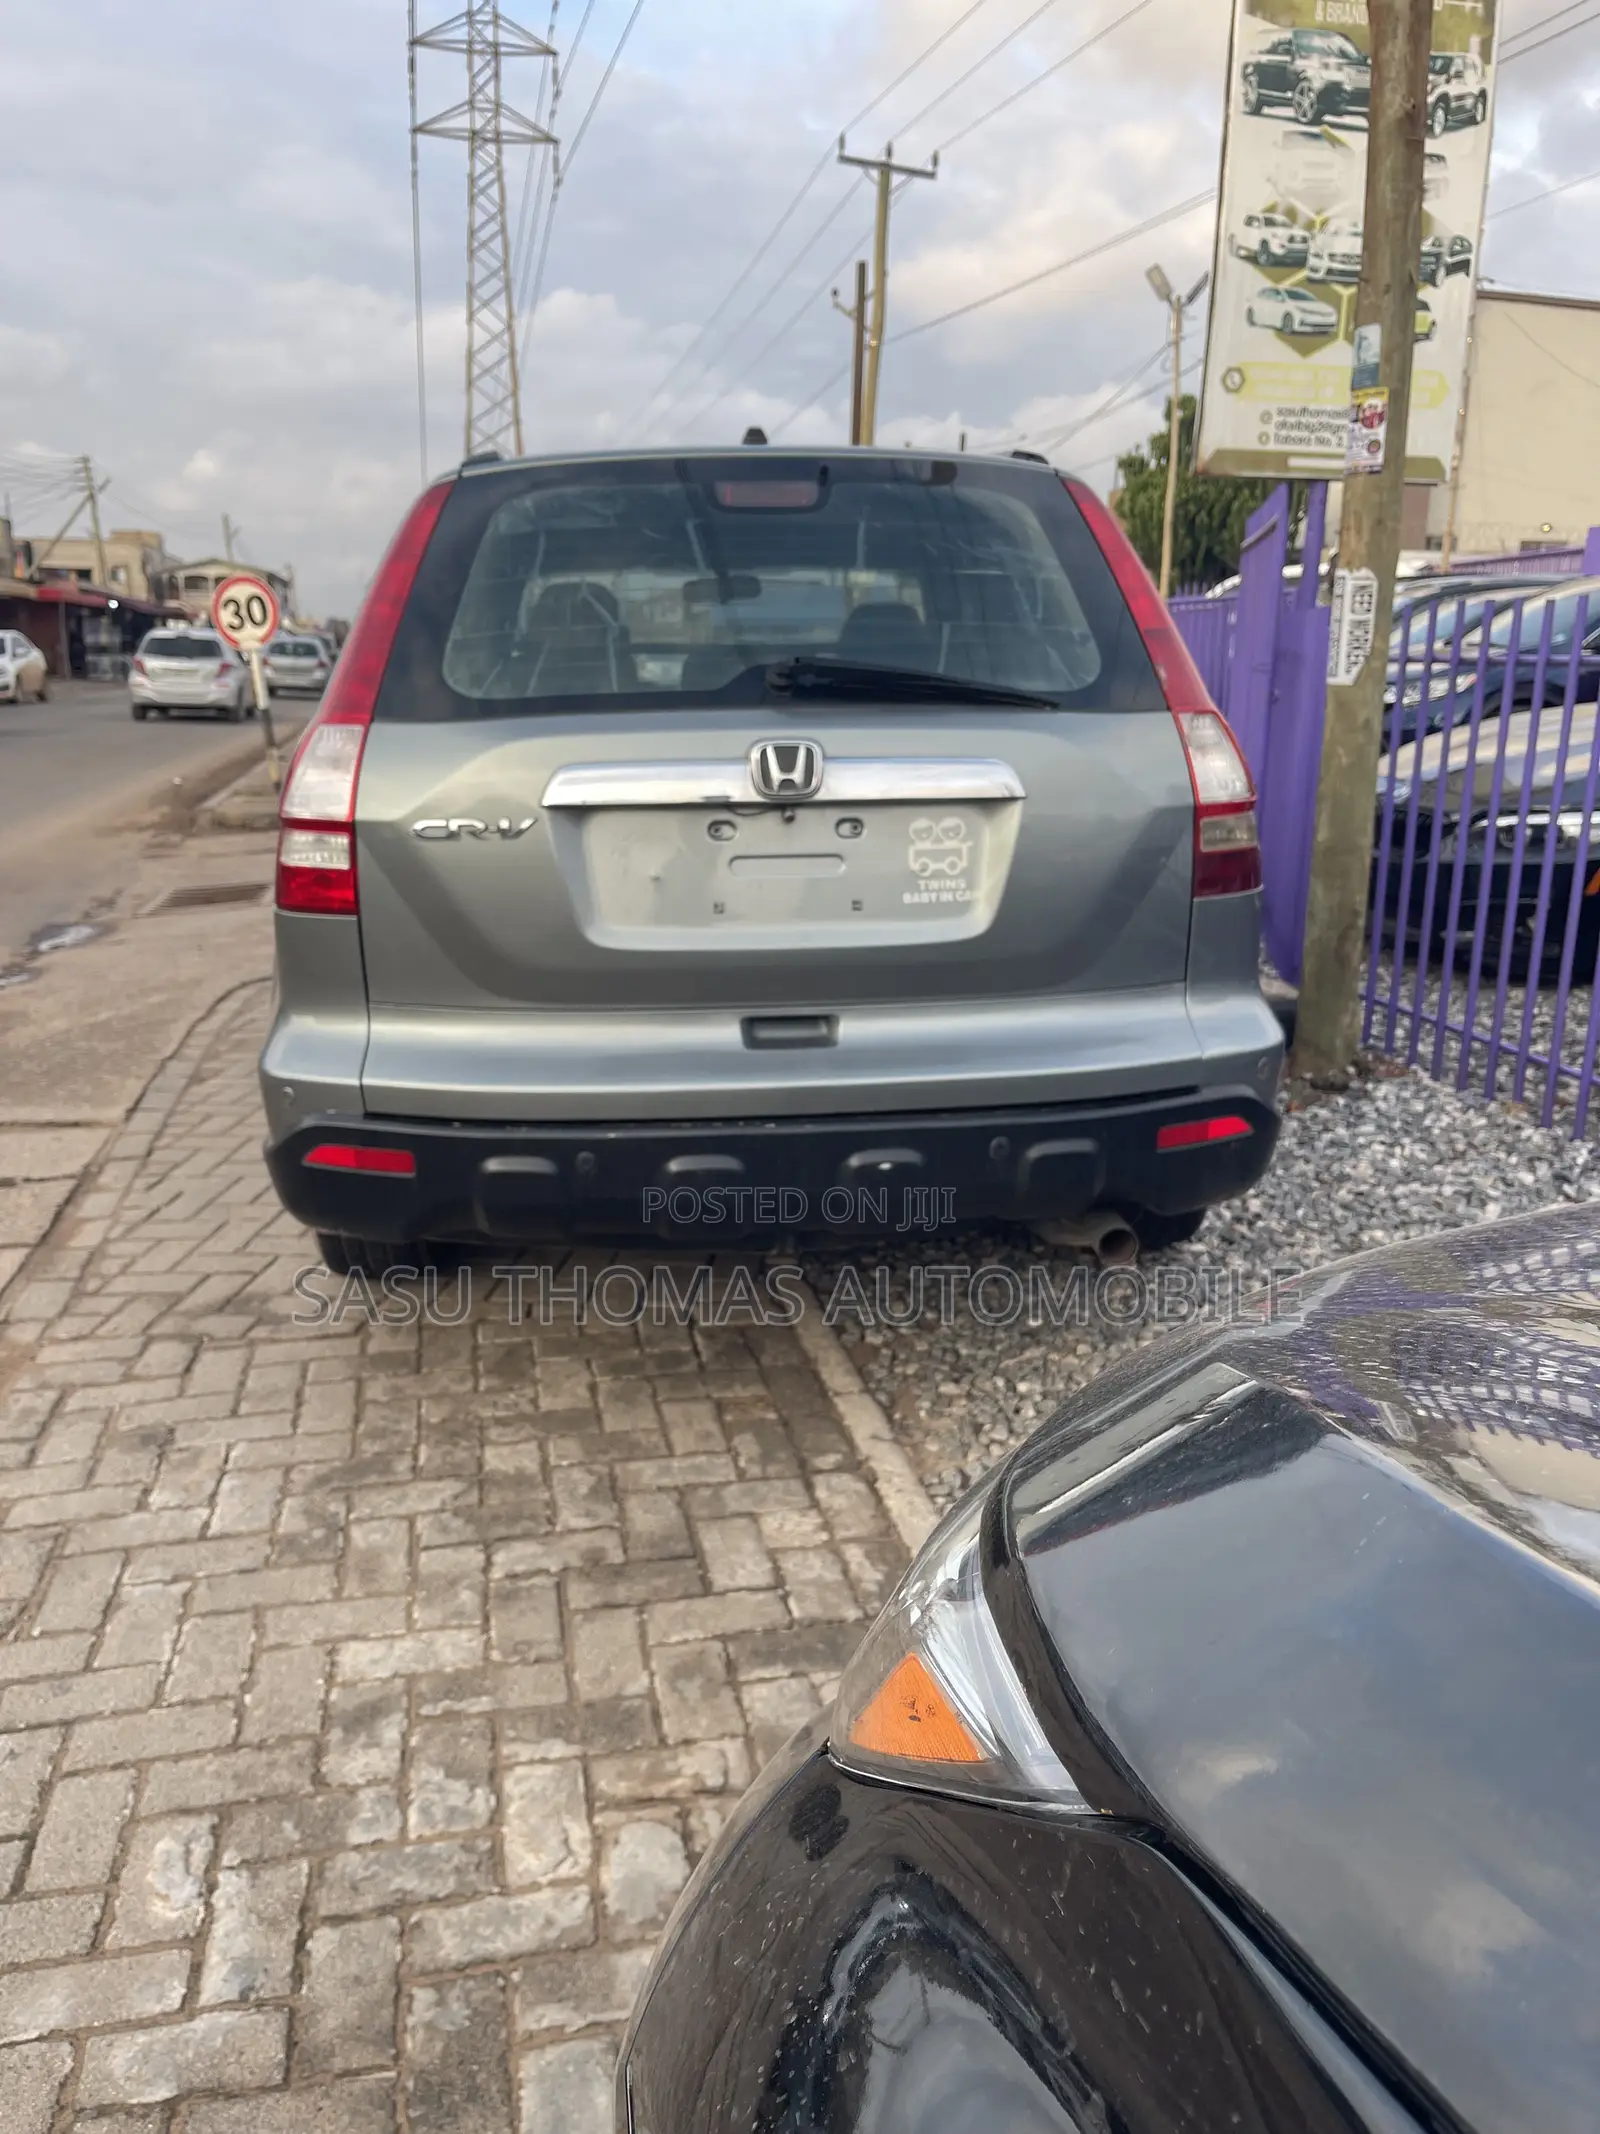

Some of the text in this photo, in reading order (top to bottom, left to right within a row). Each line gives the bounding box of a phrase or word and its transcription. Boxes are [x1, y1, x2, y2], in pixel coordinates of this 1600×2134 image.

[223, 595, 267, 630] 30
[407, 816, 538, 841] CR-V
[916, 879, 967, 892] TWINS
[902, 891, 938, 904] BABY
